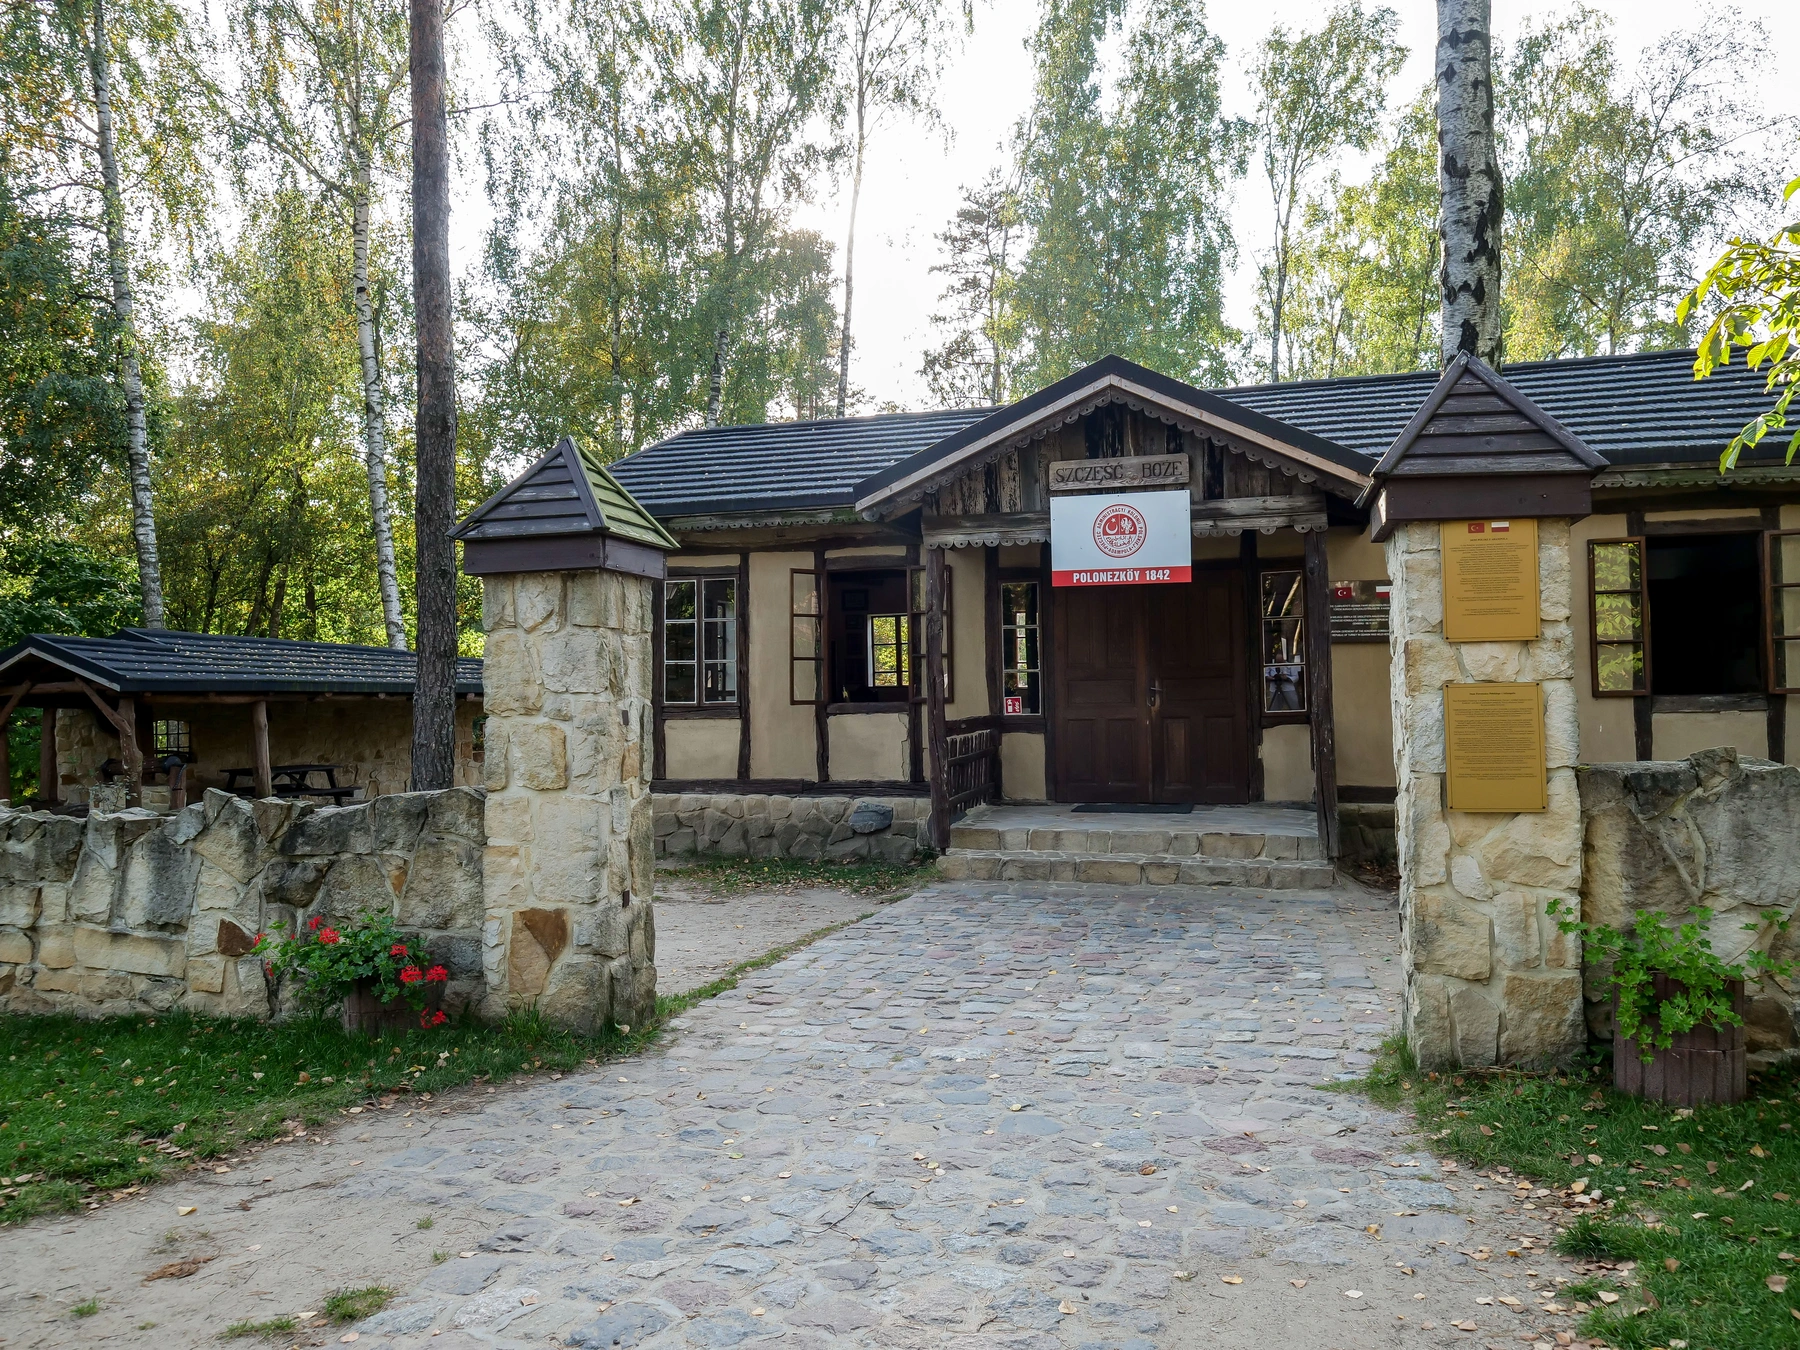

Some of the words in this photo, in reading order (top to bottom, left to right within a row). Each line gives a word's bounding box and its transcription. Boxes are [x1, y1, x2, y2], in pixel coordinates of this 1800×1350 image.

[1055, 462, 1123, 485] SZCZĘŚĆ
[1142, 459, 1182, 478] BOŻE
[1073, 568, 1140, 583] POLONEZKÖY
[1145, 569, 1170, 581] 1842
